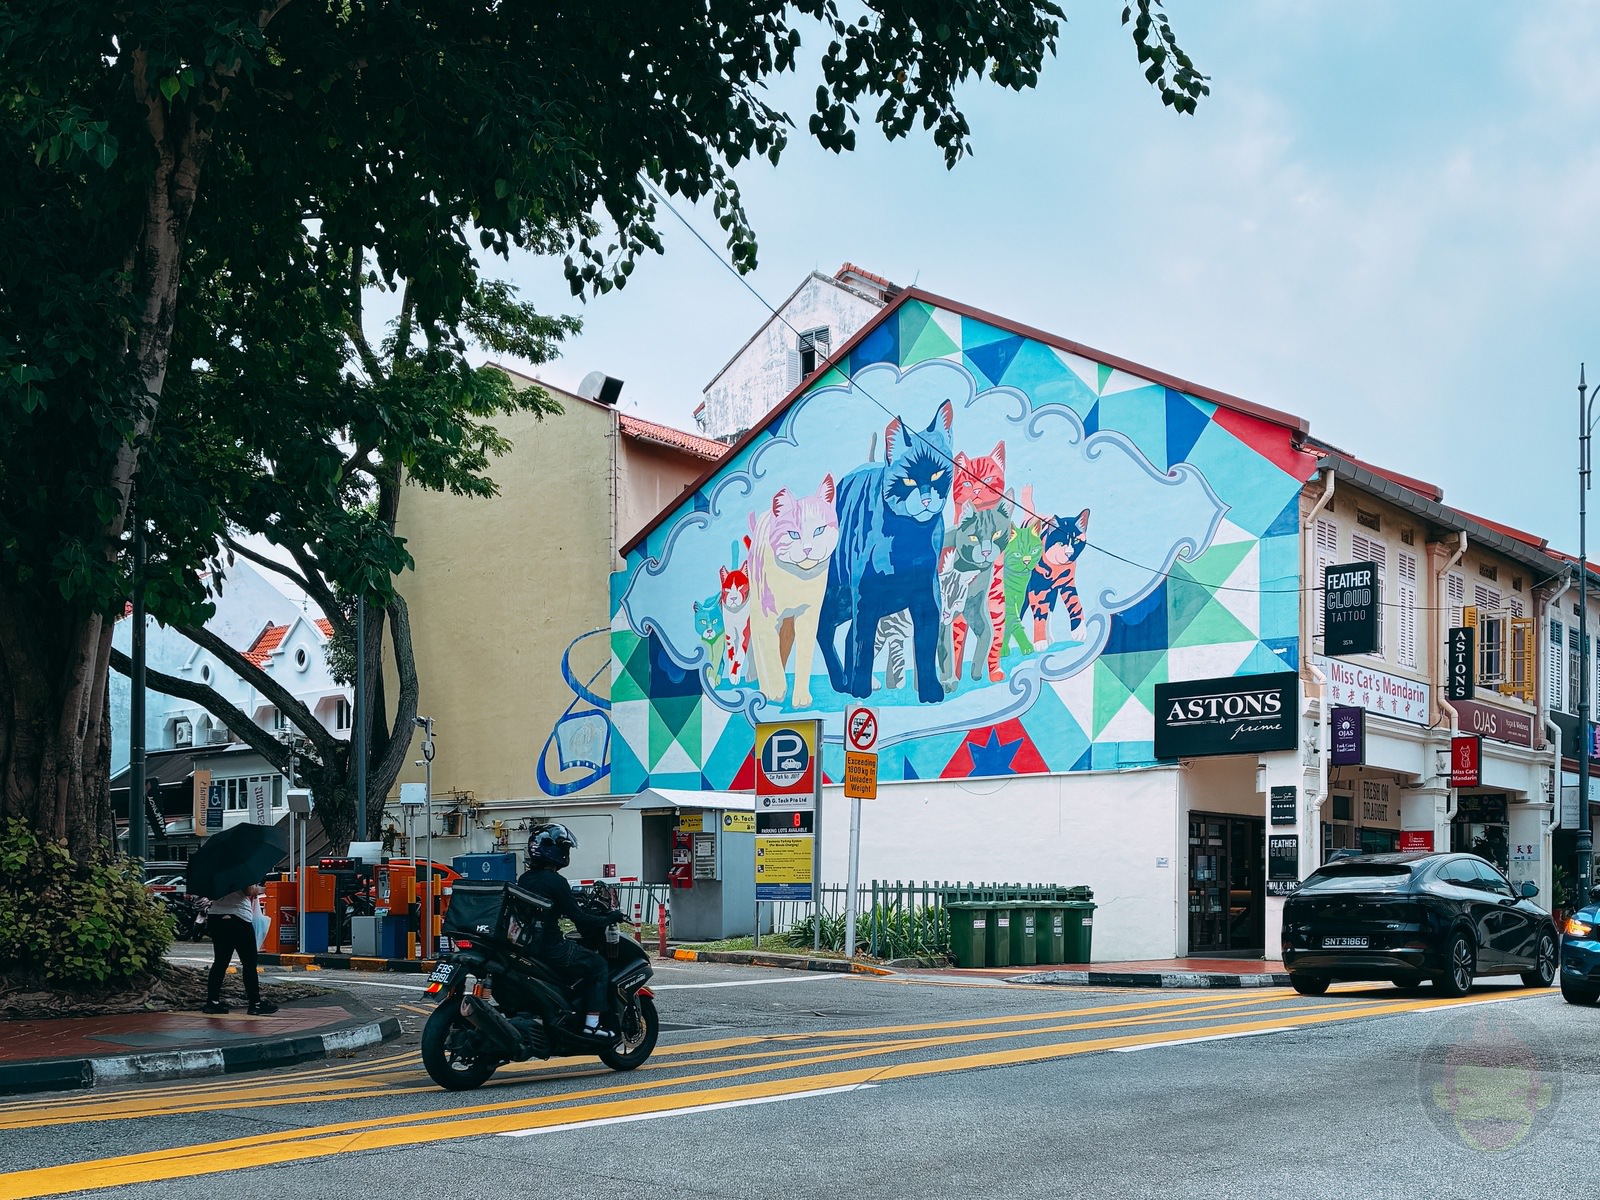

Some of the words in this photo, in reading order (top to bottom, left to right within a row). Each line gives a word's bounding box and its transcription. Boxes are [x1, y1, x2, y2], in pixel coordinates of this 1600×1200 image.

[1328, 570, 1371, 590] FEATHER
[1326, 588, 1372, 610] CLOUD
[1332, 610, 1366, 623] TATTOO
[1455, 630, 1466, 696] ASTONS
[1331, 663, 1354, 685] Miss
[1357, 670, 1380, 692] Cat's
[1383, 676, 1424, 704] Mandarin
[1166, 692, 1281, 720] ASTONS
[1230, 721, 1282, 740] prime
[1474, 710, 1496, 734] OJAS
[772, 735, 802, 771] P
[848, 756, 876, 768] Exceeding
[850, 775, 872, 784] Unladen
[851, 784, 871, 793] Weight
[1363, 781, 1380, 800] FRESH
[794, 812, 800, 827] 8
[1363, 802, 1388, 822] DRAUGHT
[1270, 848, 1296, 857] CLOUD
[436, 964, 454, 974] FBS
